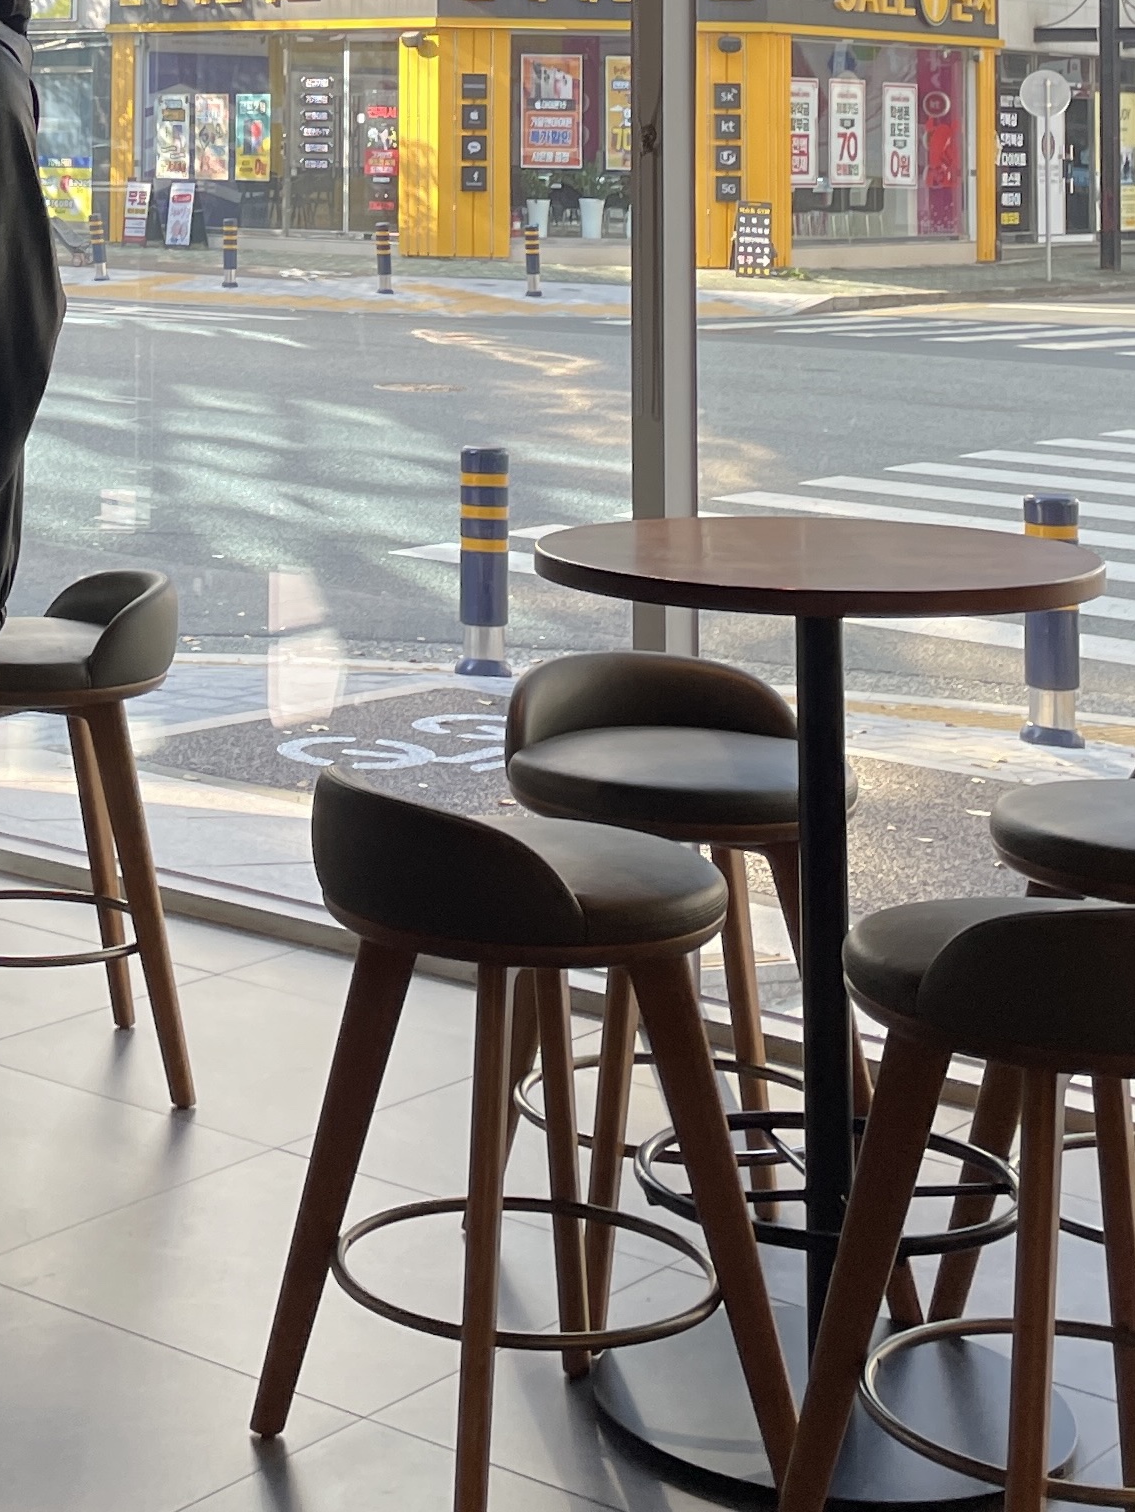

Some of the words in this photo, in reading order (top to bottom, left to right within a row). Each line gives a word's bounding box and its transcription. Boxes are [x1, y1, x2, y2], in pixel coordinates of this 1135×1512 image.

[721, 120, 736, 133] kt
[837, 131, 858, 162] 70
[721, 183, 736, 195] 5G
